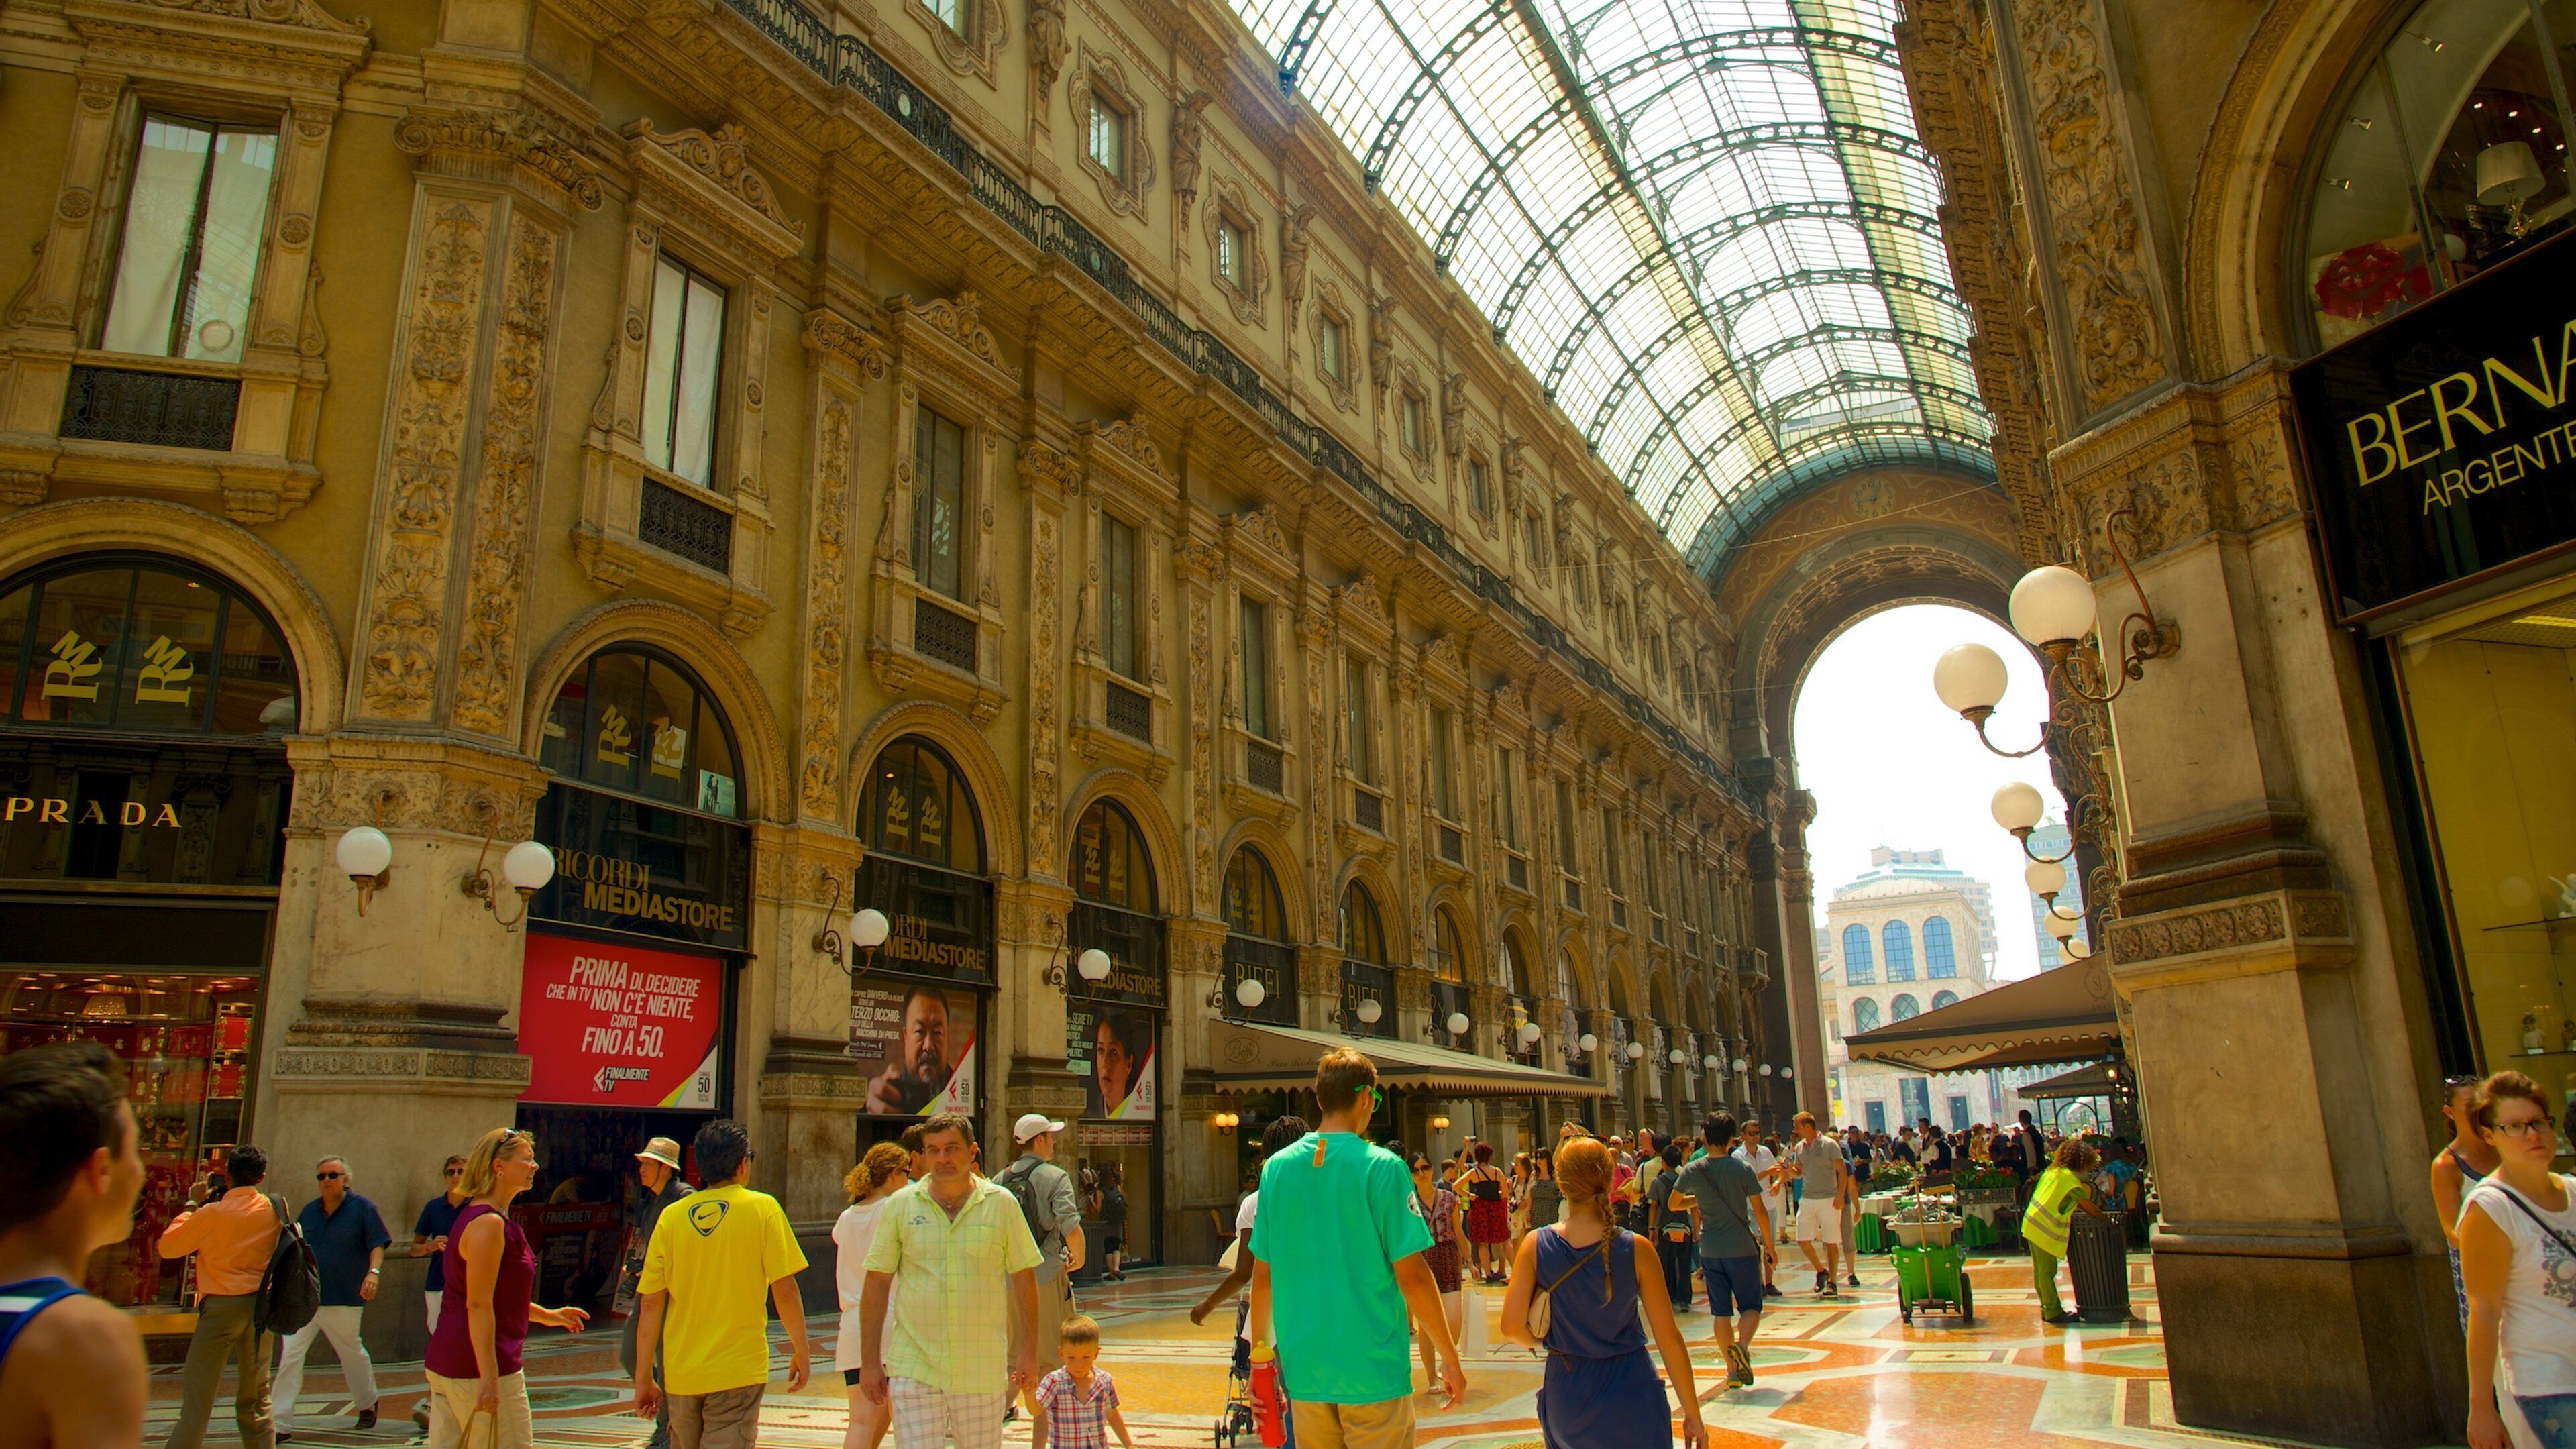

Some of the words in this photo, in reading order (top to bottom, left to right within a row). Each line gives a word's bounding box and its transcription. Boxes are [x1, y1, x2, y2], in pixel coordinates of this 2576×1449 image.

[3, 796, 182, 829] PRADA
[584, 881, 734, 932] MEDIASTORE
[883, 935, 986, 971] MEDIASTORE
[568, 955, 629, 989] PRIMA
[629, 971, 643, 990] DI
[645, 974, 702, 998] DECIDERE
[1099, 971, 1161, 996] EDIASTORE
[546, 983, 566, 1000] CHE
[566, 985, 578, 1000] IN
[579, 986, 592, 1002] TV
[590, 987, 621, 1012] NON
[646, 996, 695, 1023] NIENTE,
[851, 1006, 873, 1020] TERZO
[874, 1008, 900, 1022] OCCHIO:
[610, 1013, 638, 1029] CONTA
[581, 1026, 621, 1055] FINO
[622, 1030, 635, 1056] A
[637, 1025, 665, 1058] 50.
[1228, 1040, 1255, 1062] Biffi
[605, 1067, 649, 1081] FINALMENTE
[1267, 1058, 1287, 1068] Bar
[604, 1079, 615, 1092] TV
[698, 1077, 710, 1093] 50
[961, 1083, 969, 1099] 50
